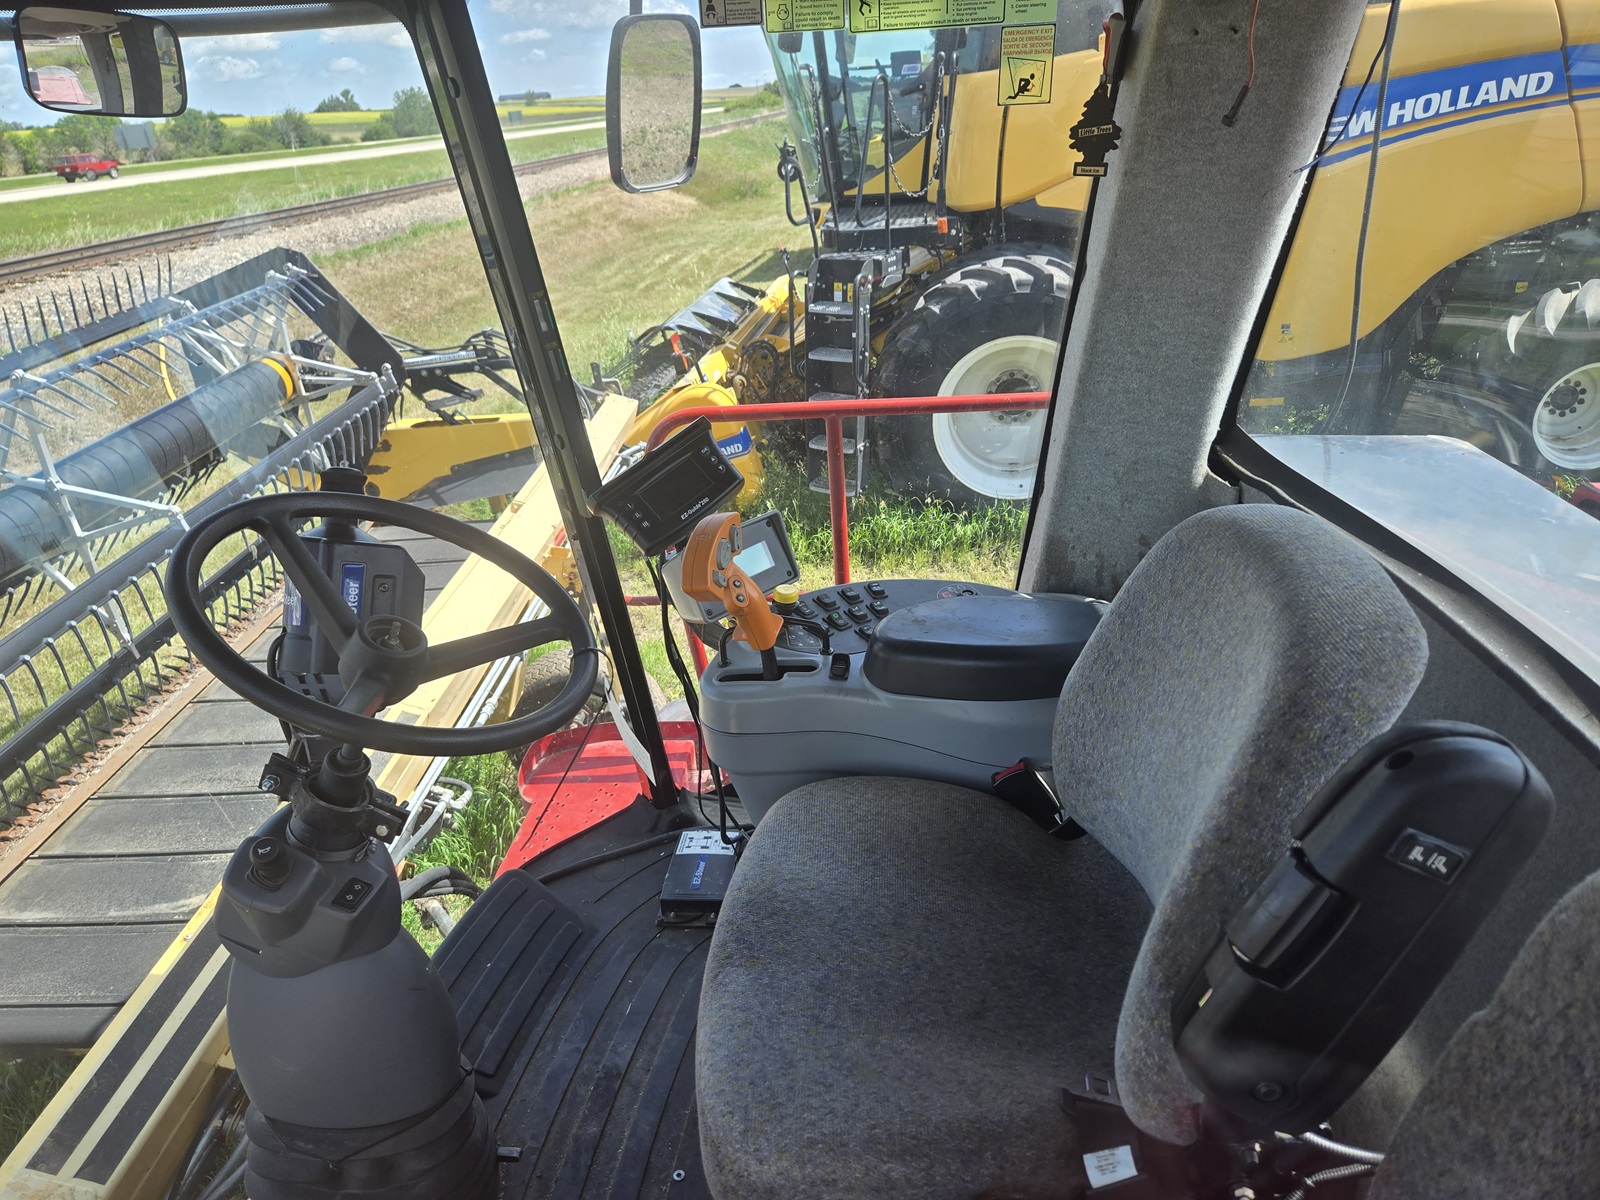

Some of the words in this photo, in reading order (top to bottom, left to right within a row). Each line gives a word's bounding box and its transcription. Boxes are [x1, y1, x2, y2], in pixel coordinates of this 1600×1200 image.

[1387, 71, 1554, 127] HOLLAND
[1081, 129, 1095, 137] Little
[1096, 126, 1111, 134] Trees
